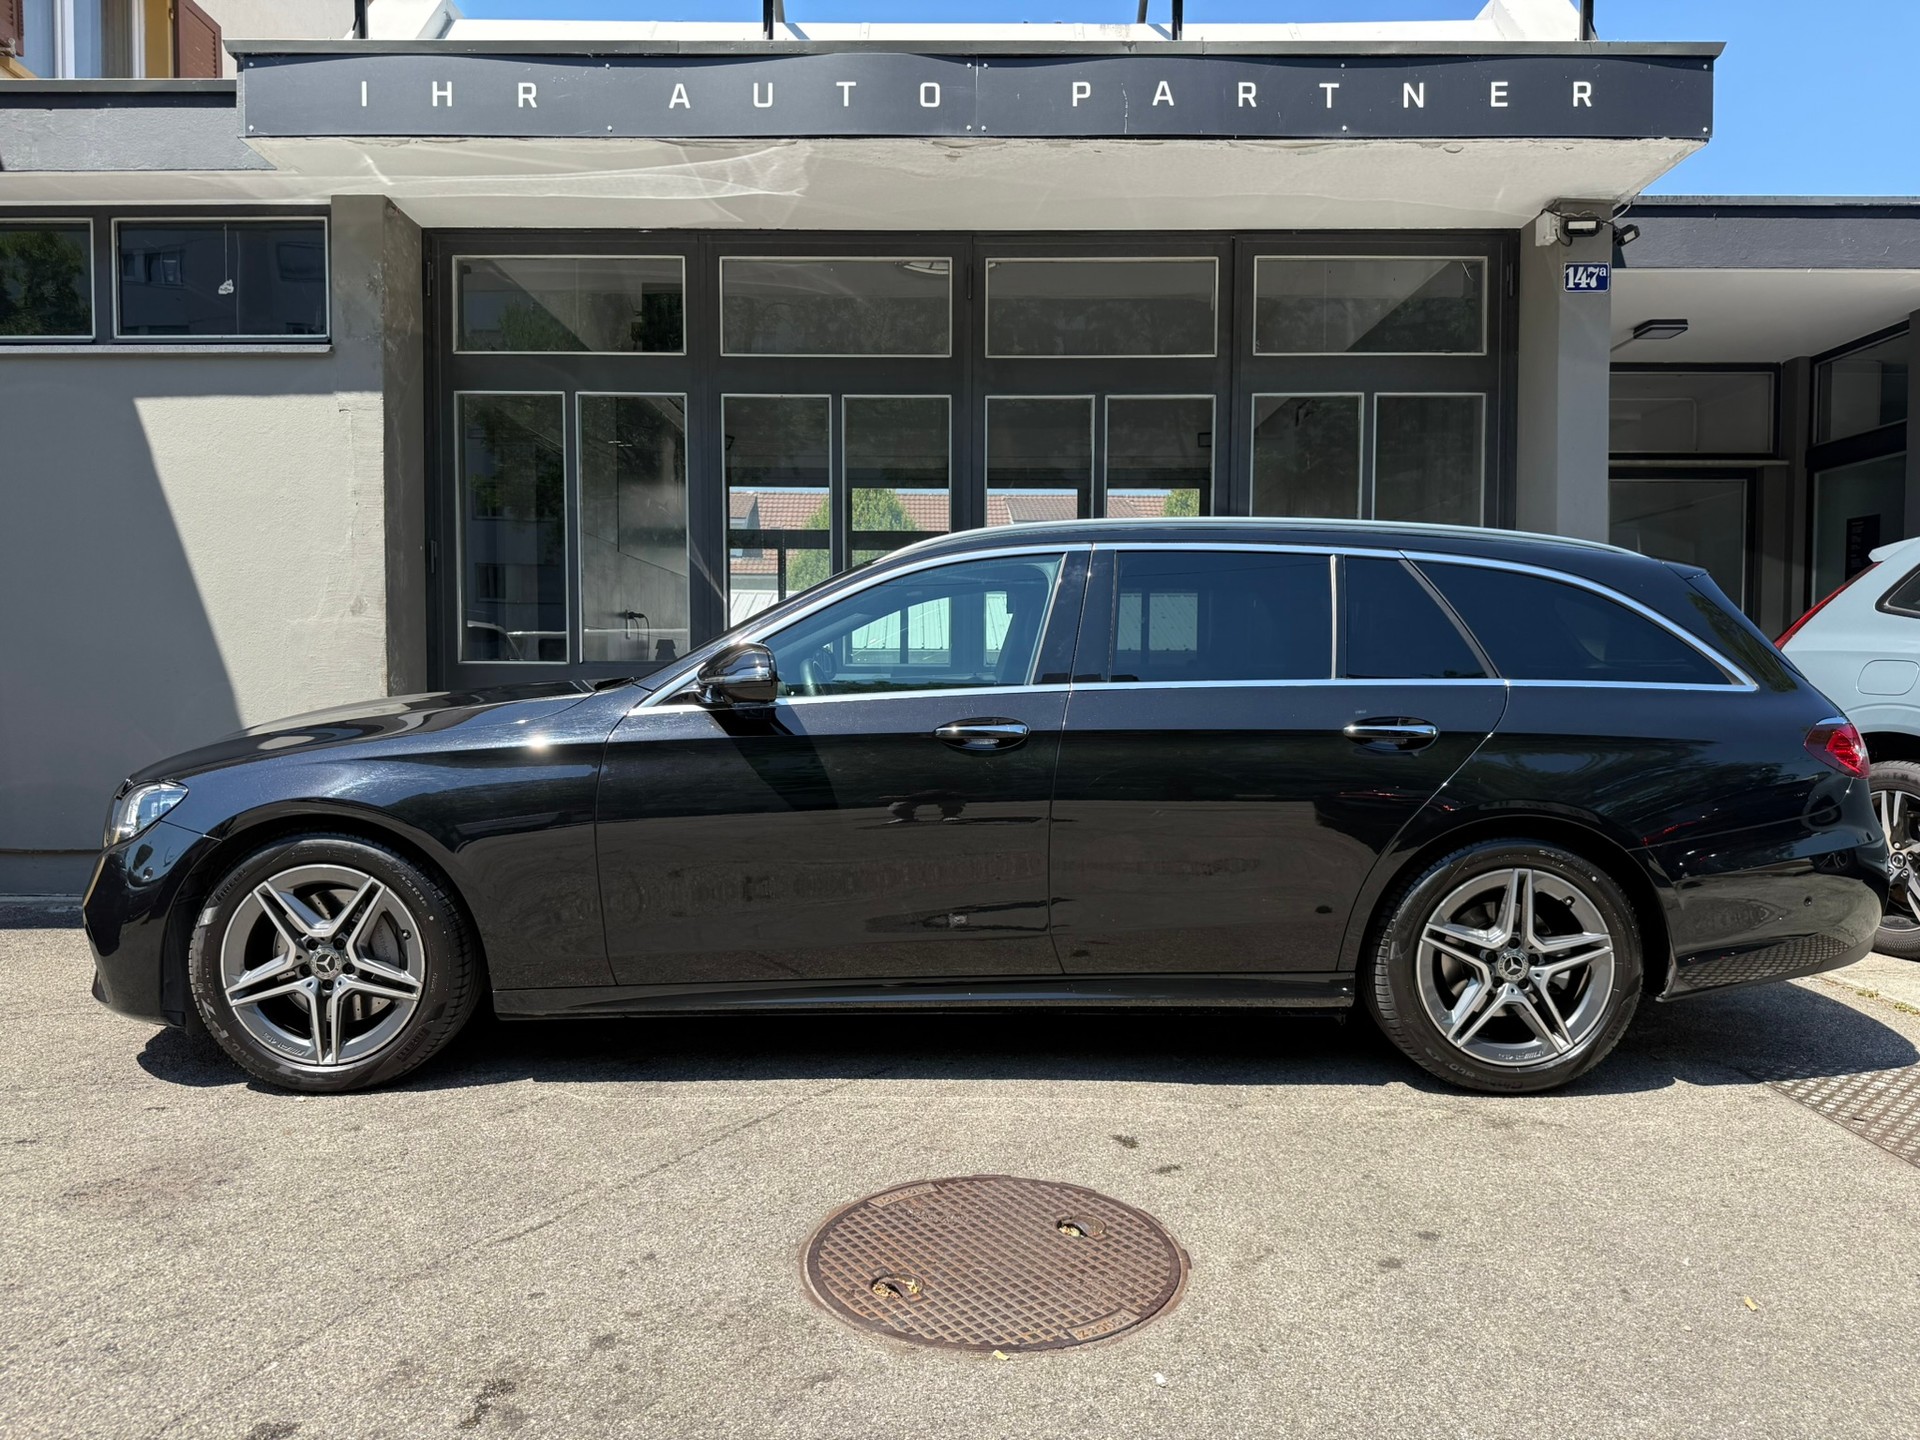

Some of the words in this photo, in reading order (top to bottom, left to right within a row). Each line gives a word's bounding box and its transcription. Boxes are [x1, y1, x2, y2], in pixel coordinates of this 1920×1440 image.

[360, 80, 538, 109] IHR
[668, 80, 941, 110] AUTO
[1072, 80, 1592, 109] PARTNER
[1565, 266, 1607, 289] 147a
